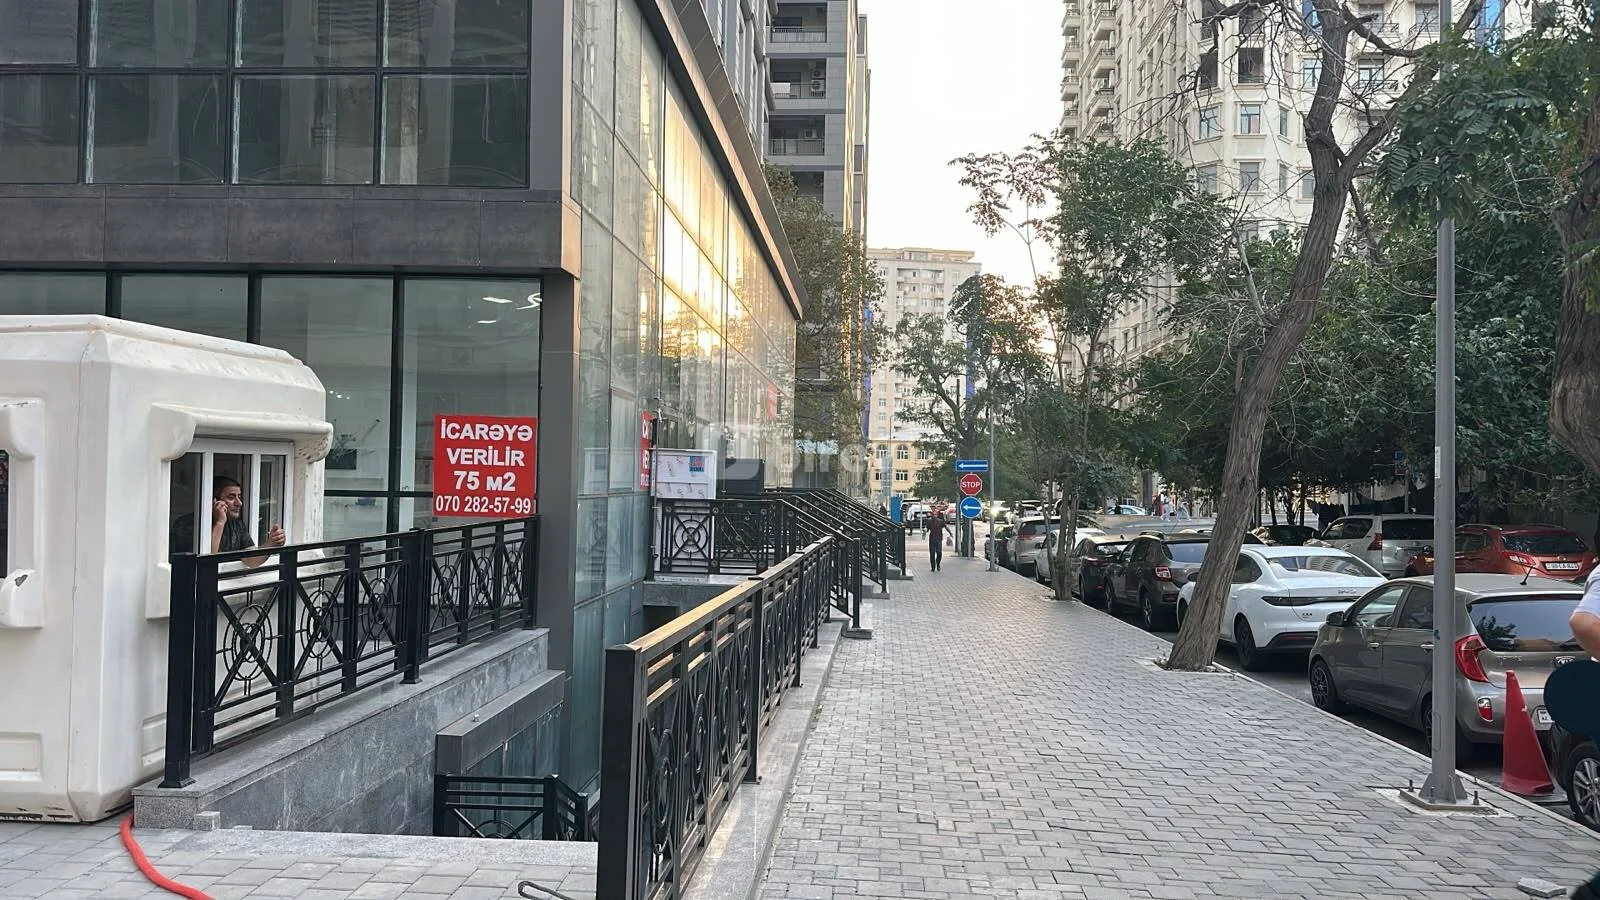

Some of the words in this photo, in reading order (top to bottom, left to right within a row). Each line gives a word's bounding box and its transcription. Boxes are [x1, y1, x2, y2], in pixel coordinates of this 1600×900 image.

[440, 418, 533, 442] İCARƏYƏ
[446, 445, 525, 467] VERİLİR
[453, 470, 480, 491] 75
[435, 495, 460, 512] 070
[464, 496, 531, 514] 282-57-99
